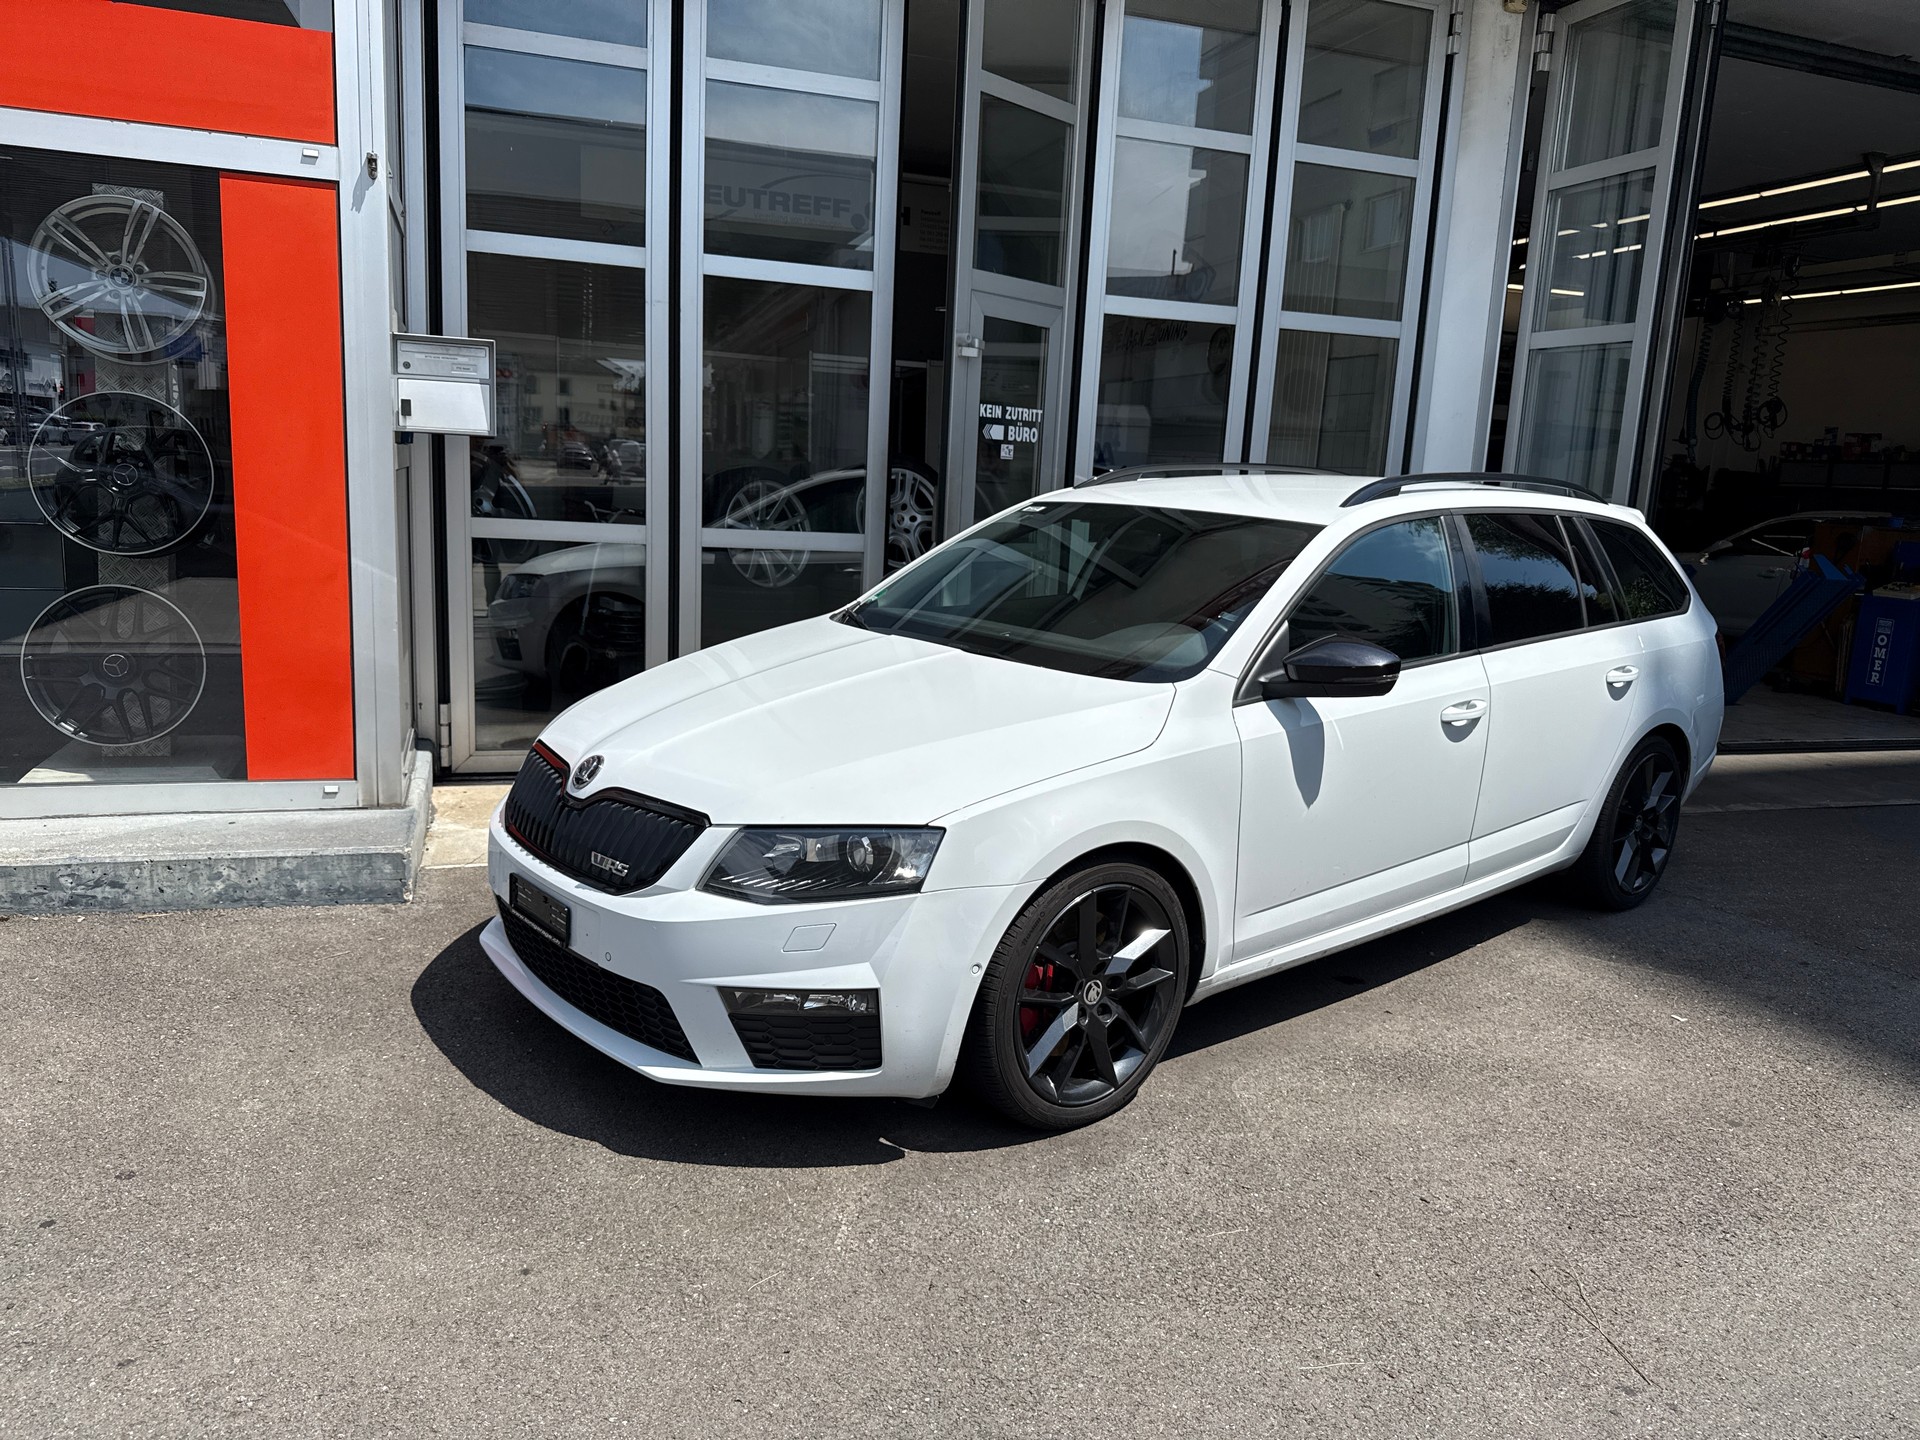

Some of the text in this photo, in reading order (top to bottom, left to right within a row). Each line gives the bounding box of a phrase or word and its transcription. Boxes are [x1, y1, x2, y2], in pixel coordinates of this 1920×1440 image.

[980, 403, 1043, 423] KEIN ZUTRITT
[1007, 422, 1038, 443] BÜRO
[1870, 634, 1888, 684] OMER
